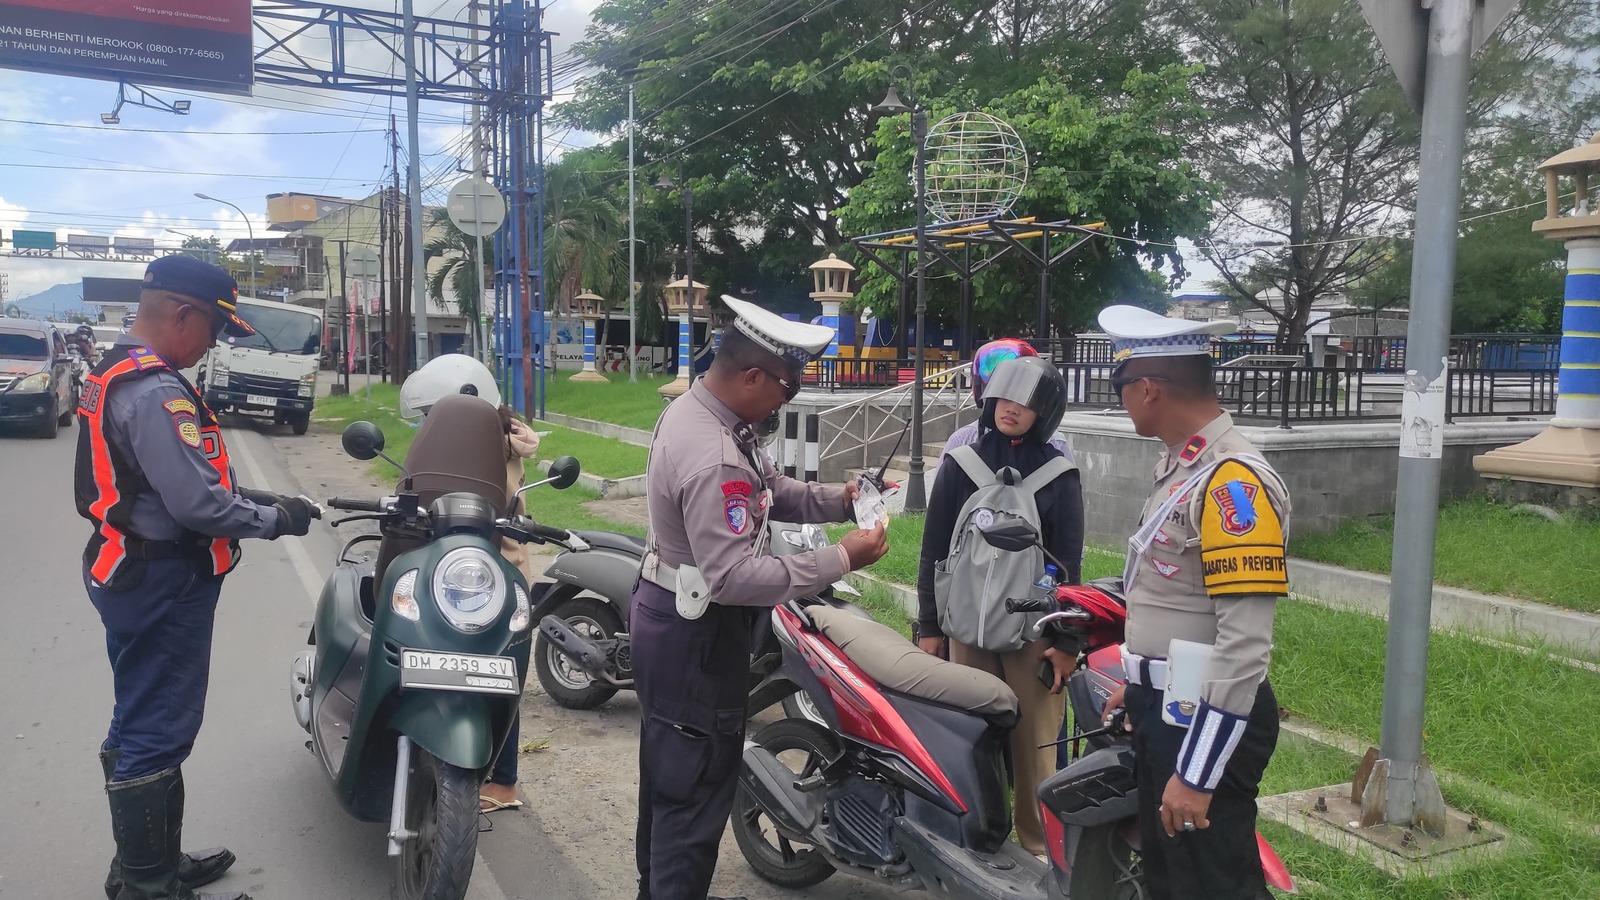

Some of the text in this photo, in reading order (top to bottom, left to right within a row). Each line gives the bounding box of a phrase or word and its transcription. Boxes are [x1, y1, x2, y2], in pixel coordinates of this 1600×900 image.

[12, 41, 47, 53] TAHUN
[49, 45, 72, 55] DAN
[73, 48, 136, 63] PEREMPUAN
[138, 56, 168, 67] HAMIL
[25, 28, 84, 43] BERHENTI
[86, 36, 144, 50] MEROKOK
[146, 43, 225, 61] (0800-177-6565)
[409, 654, 507, 675] DM 2359 SV
